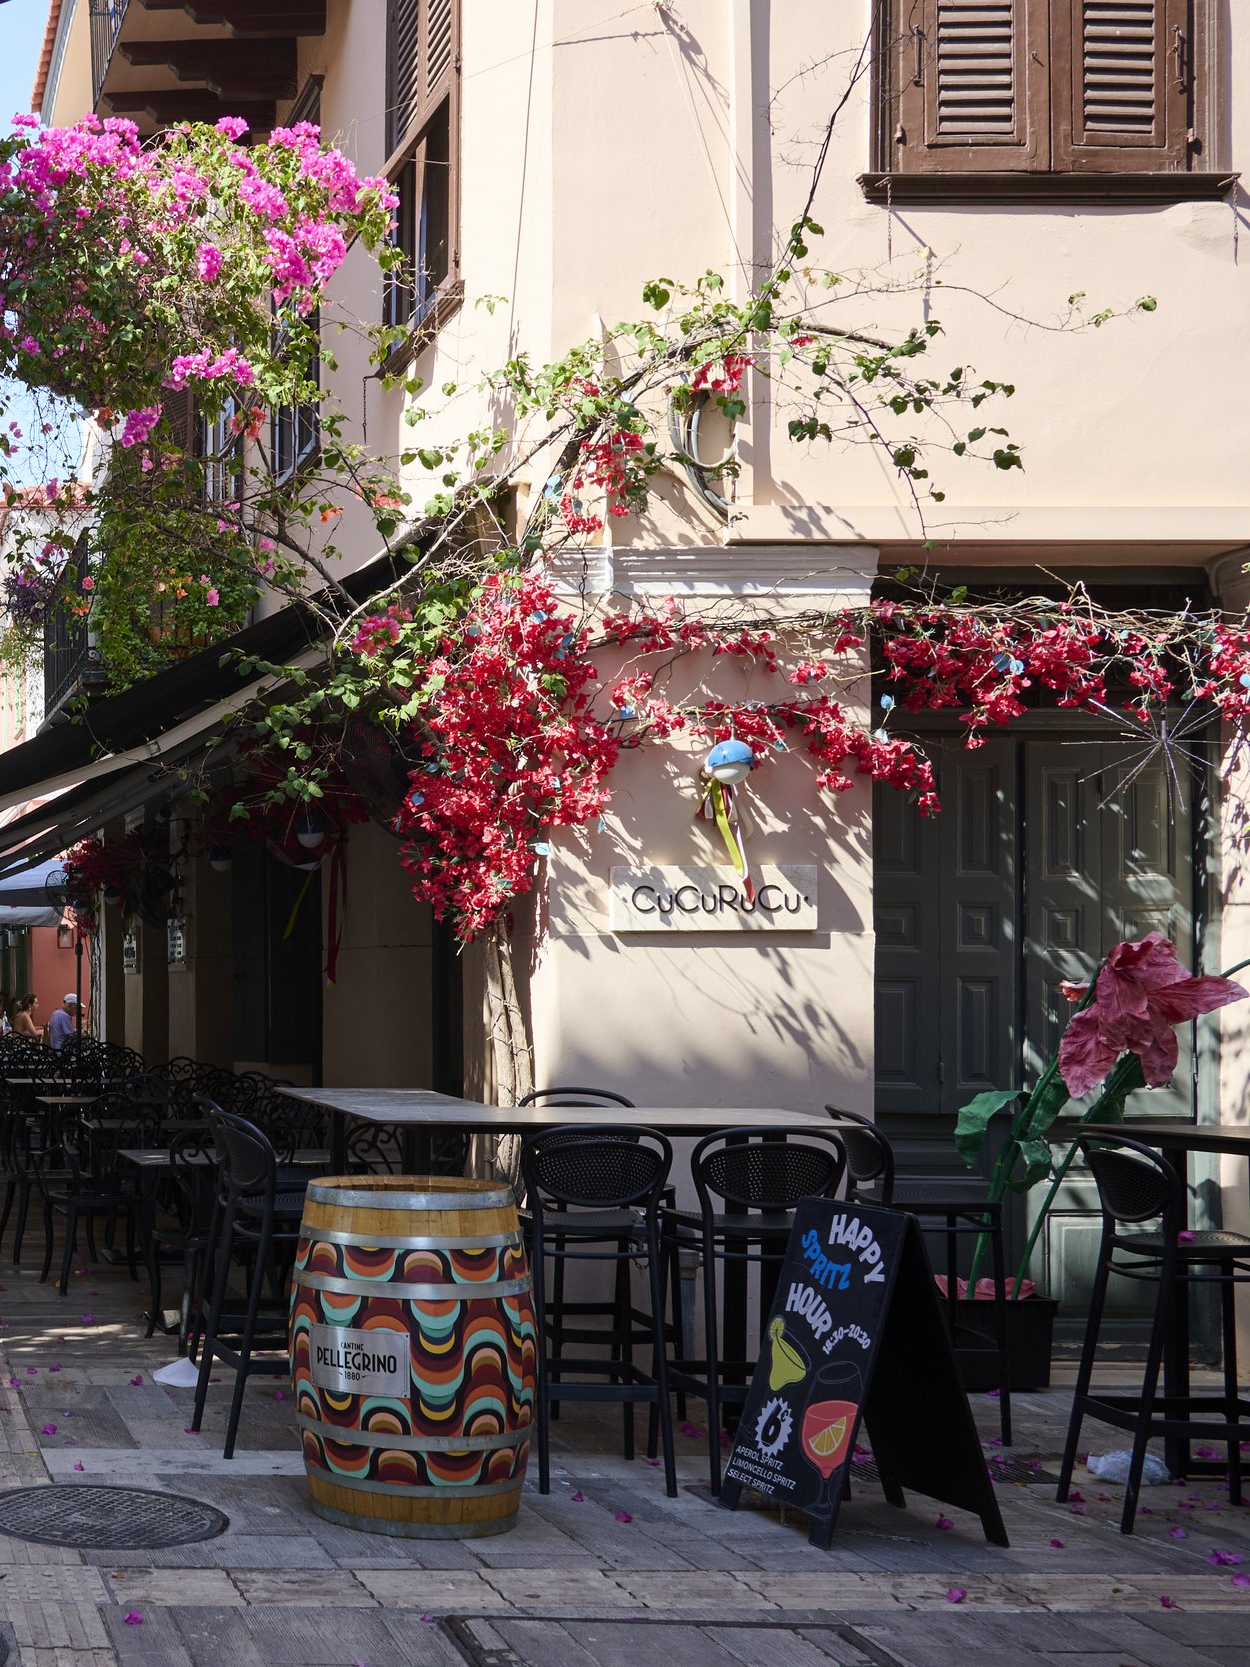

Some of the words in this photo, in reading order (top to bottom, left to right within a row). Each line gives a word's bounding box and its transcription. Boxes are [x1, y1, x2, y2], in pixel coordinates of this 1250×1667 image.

[802, 1229, 852, 1290] SPRITZ
[828, 1214, 885, 1284] HAPPY
[786, 1282, 832, 1340] HOUR
[316, 1346, 397, 1374] PELLEGRINO
[340, 1342, 364, 1351] CANTINE
[344, 1370, 360, 1380] 1880
[736, 1445, 760, 1460] APEROL
[760, 1455, 784, 1470] SPRITZ
[727, 1468, 752, 1484] SELECT
[752, 1479, 775, 1494] SPRITZ
[732, 1457, 772, 1480] LIMONCELLO
[773, 1474, 796, 1490] SPRITZ
